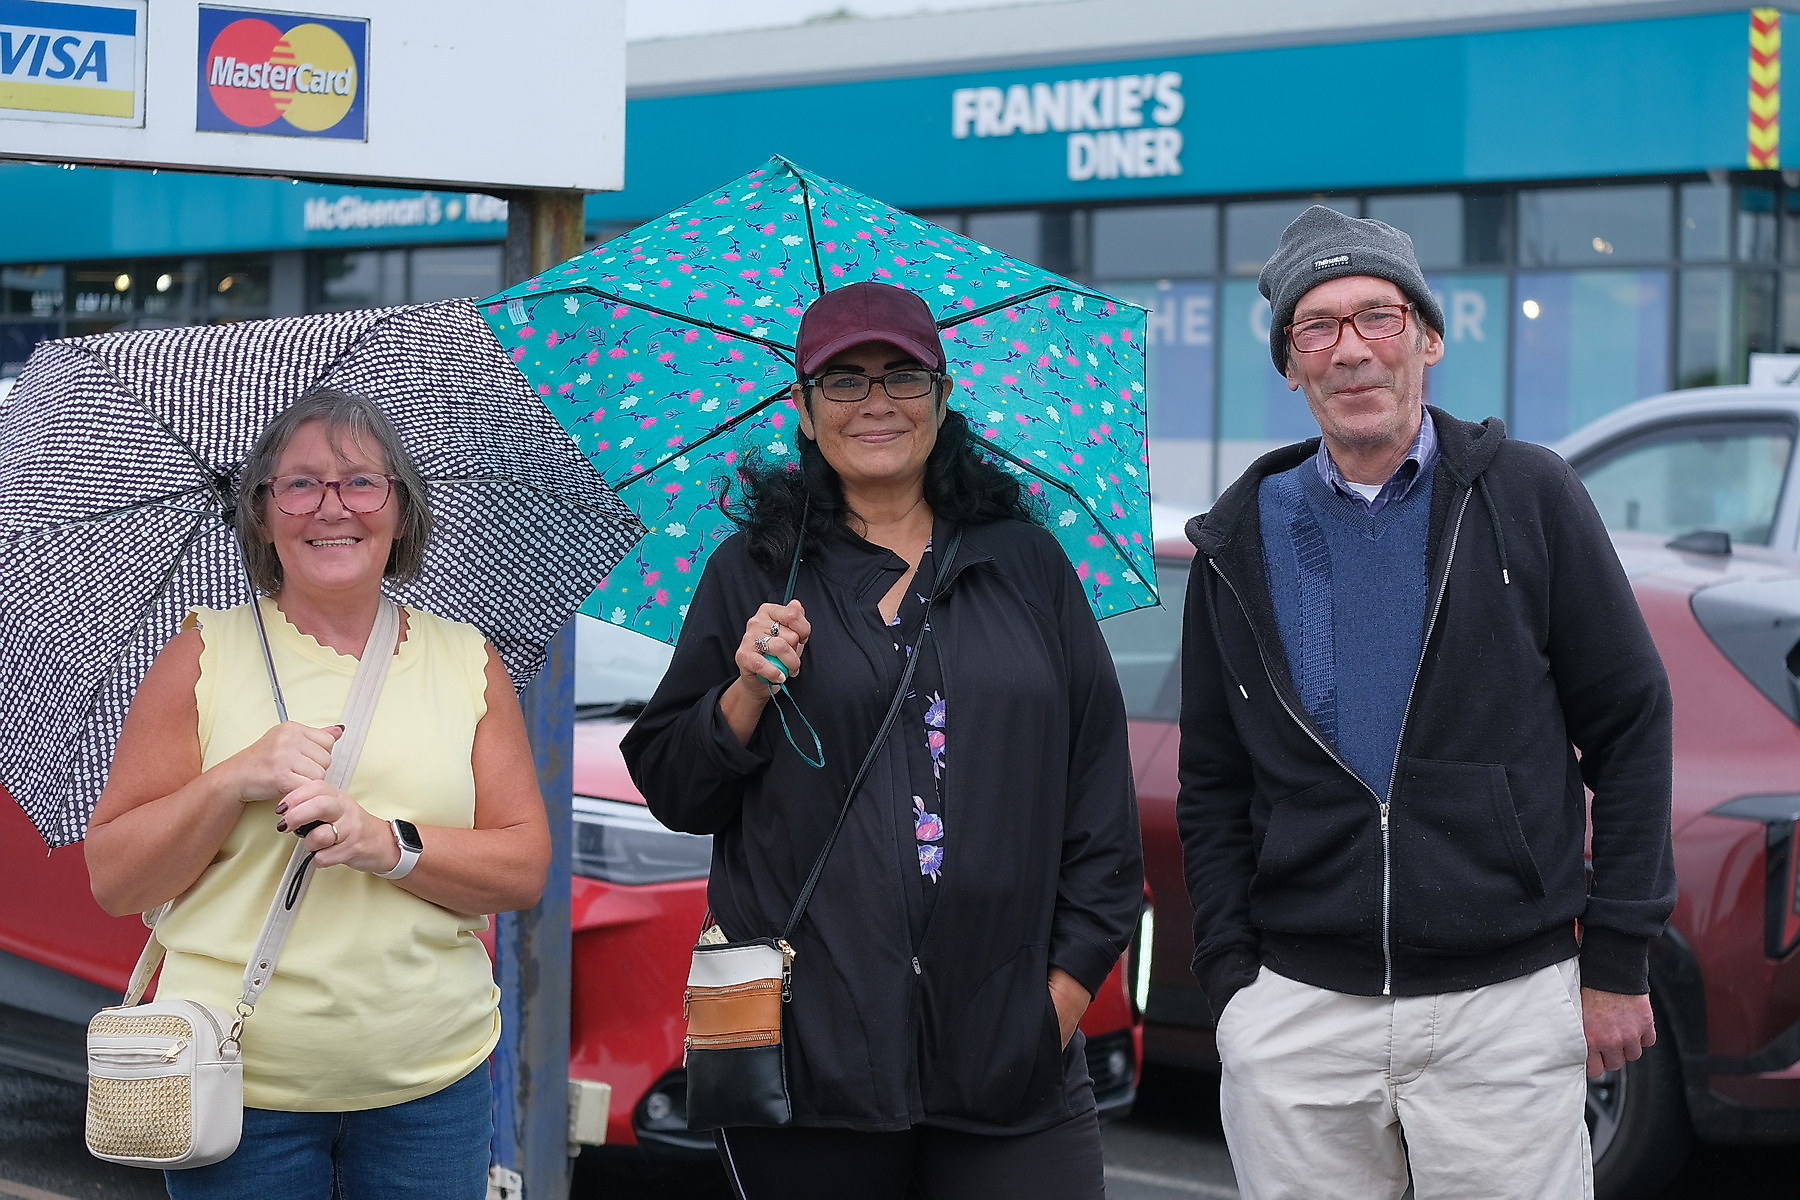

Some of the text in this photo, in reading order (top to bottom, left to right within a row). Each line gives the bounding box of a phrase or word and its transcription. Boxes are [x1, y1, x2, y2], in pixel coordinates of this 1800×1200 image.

[0, 32, 108, 82] VISA
[210, 55, 353, 96] MasterCard
[952, 71, 1184, 139] FRANKIE'S
[1066, 127, 1183, 181] DINER
